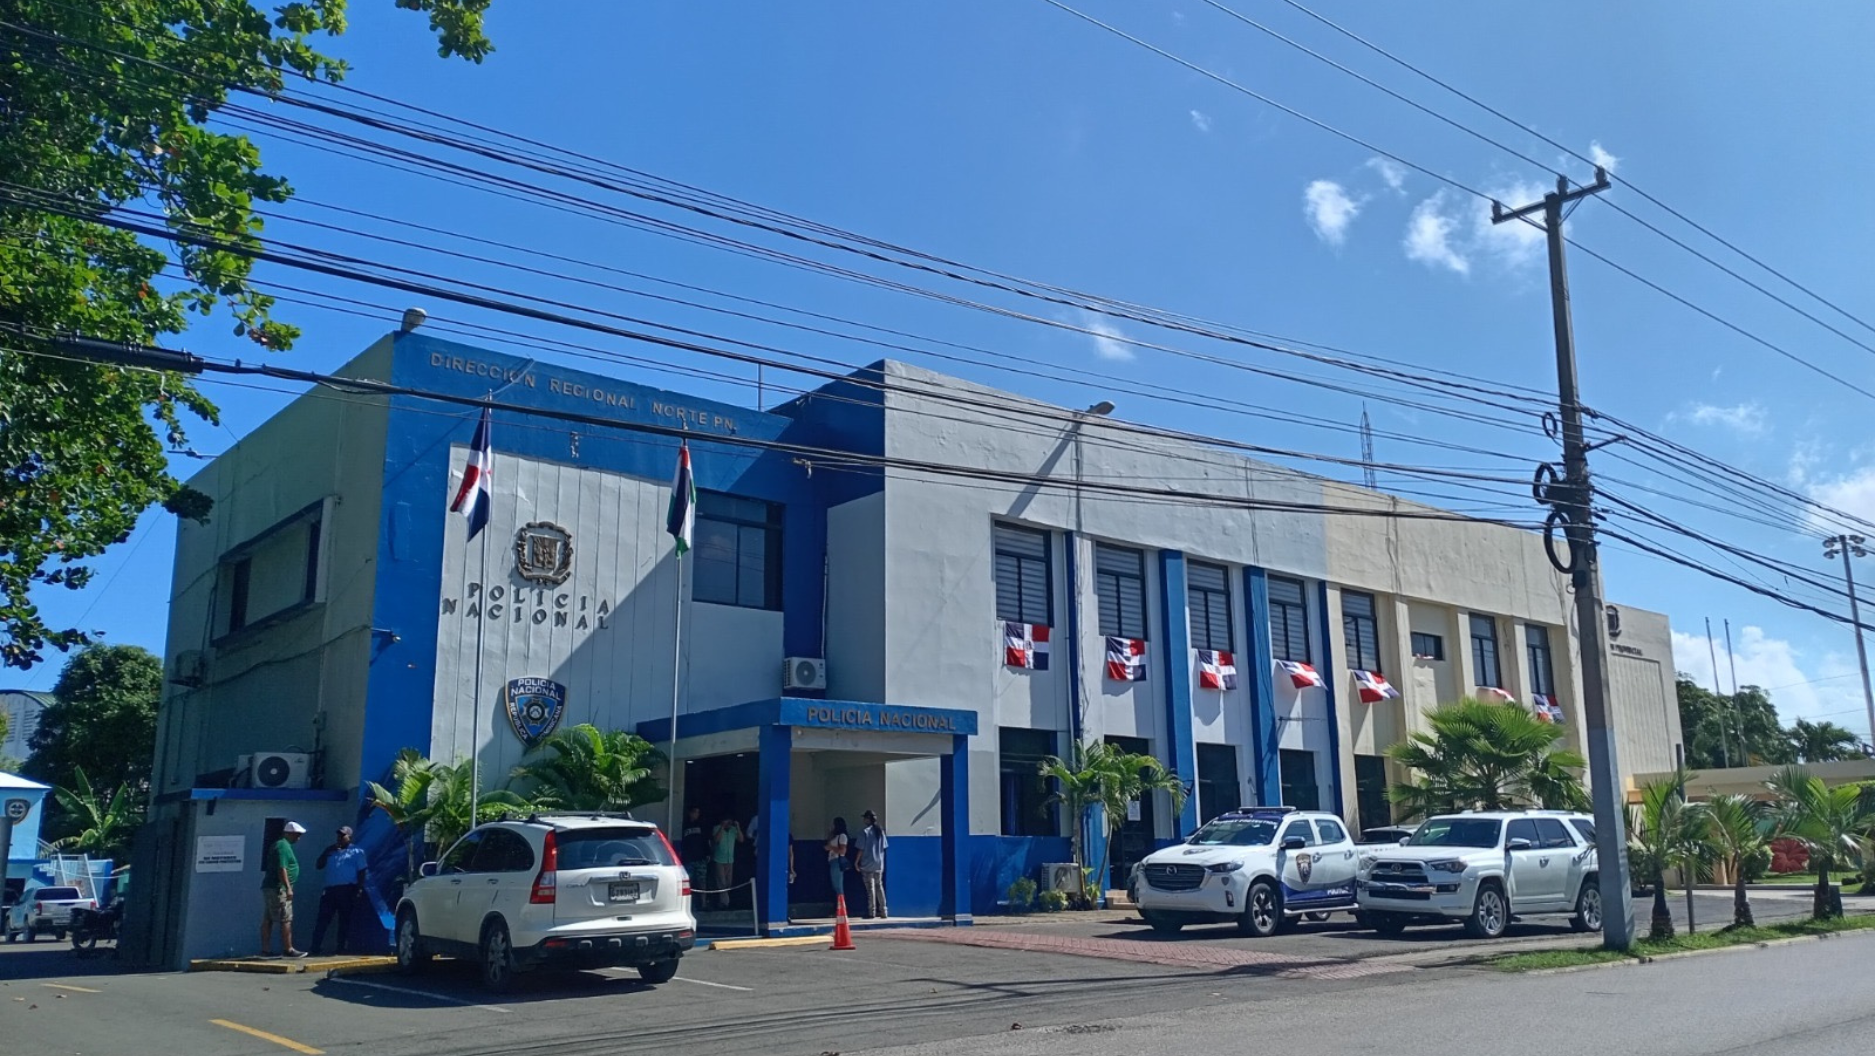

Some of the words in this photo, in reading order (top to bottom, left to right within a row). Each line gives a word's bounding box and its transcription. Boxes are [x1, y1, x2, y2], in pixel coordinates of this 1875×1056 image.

[430, 352, 535, 388] DIRECCION
[549, 378, 636, 410] REGIONAL
[652, 401, 708, 425] NORTE
[467, 582, 609, 615] POLICIA
[442, 598, 608, 630] NACIONAL
[511, 685, 561, 701] NACIONAL
[517, 678, 556, 690] POLICIA
[808, 707, 872, 725] POLICIA
[879, 711, 957, 731] NACIONAL
